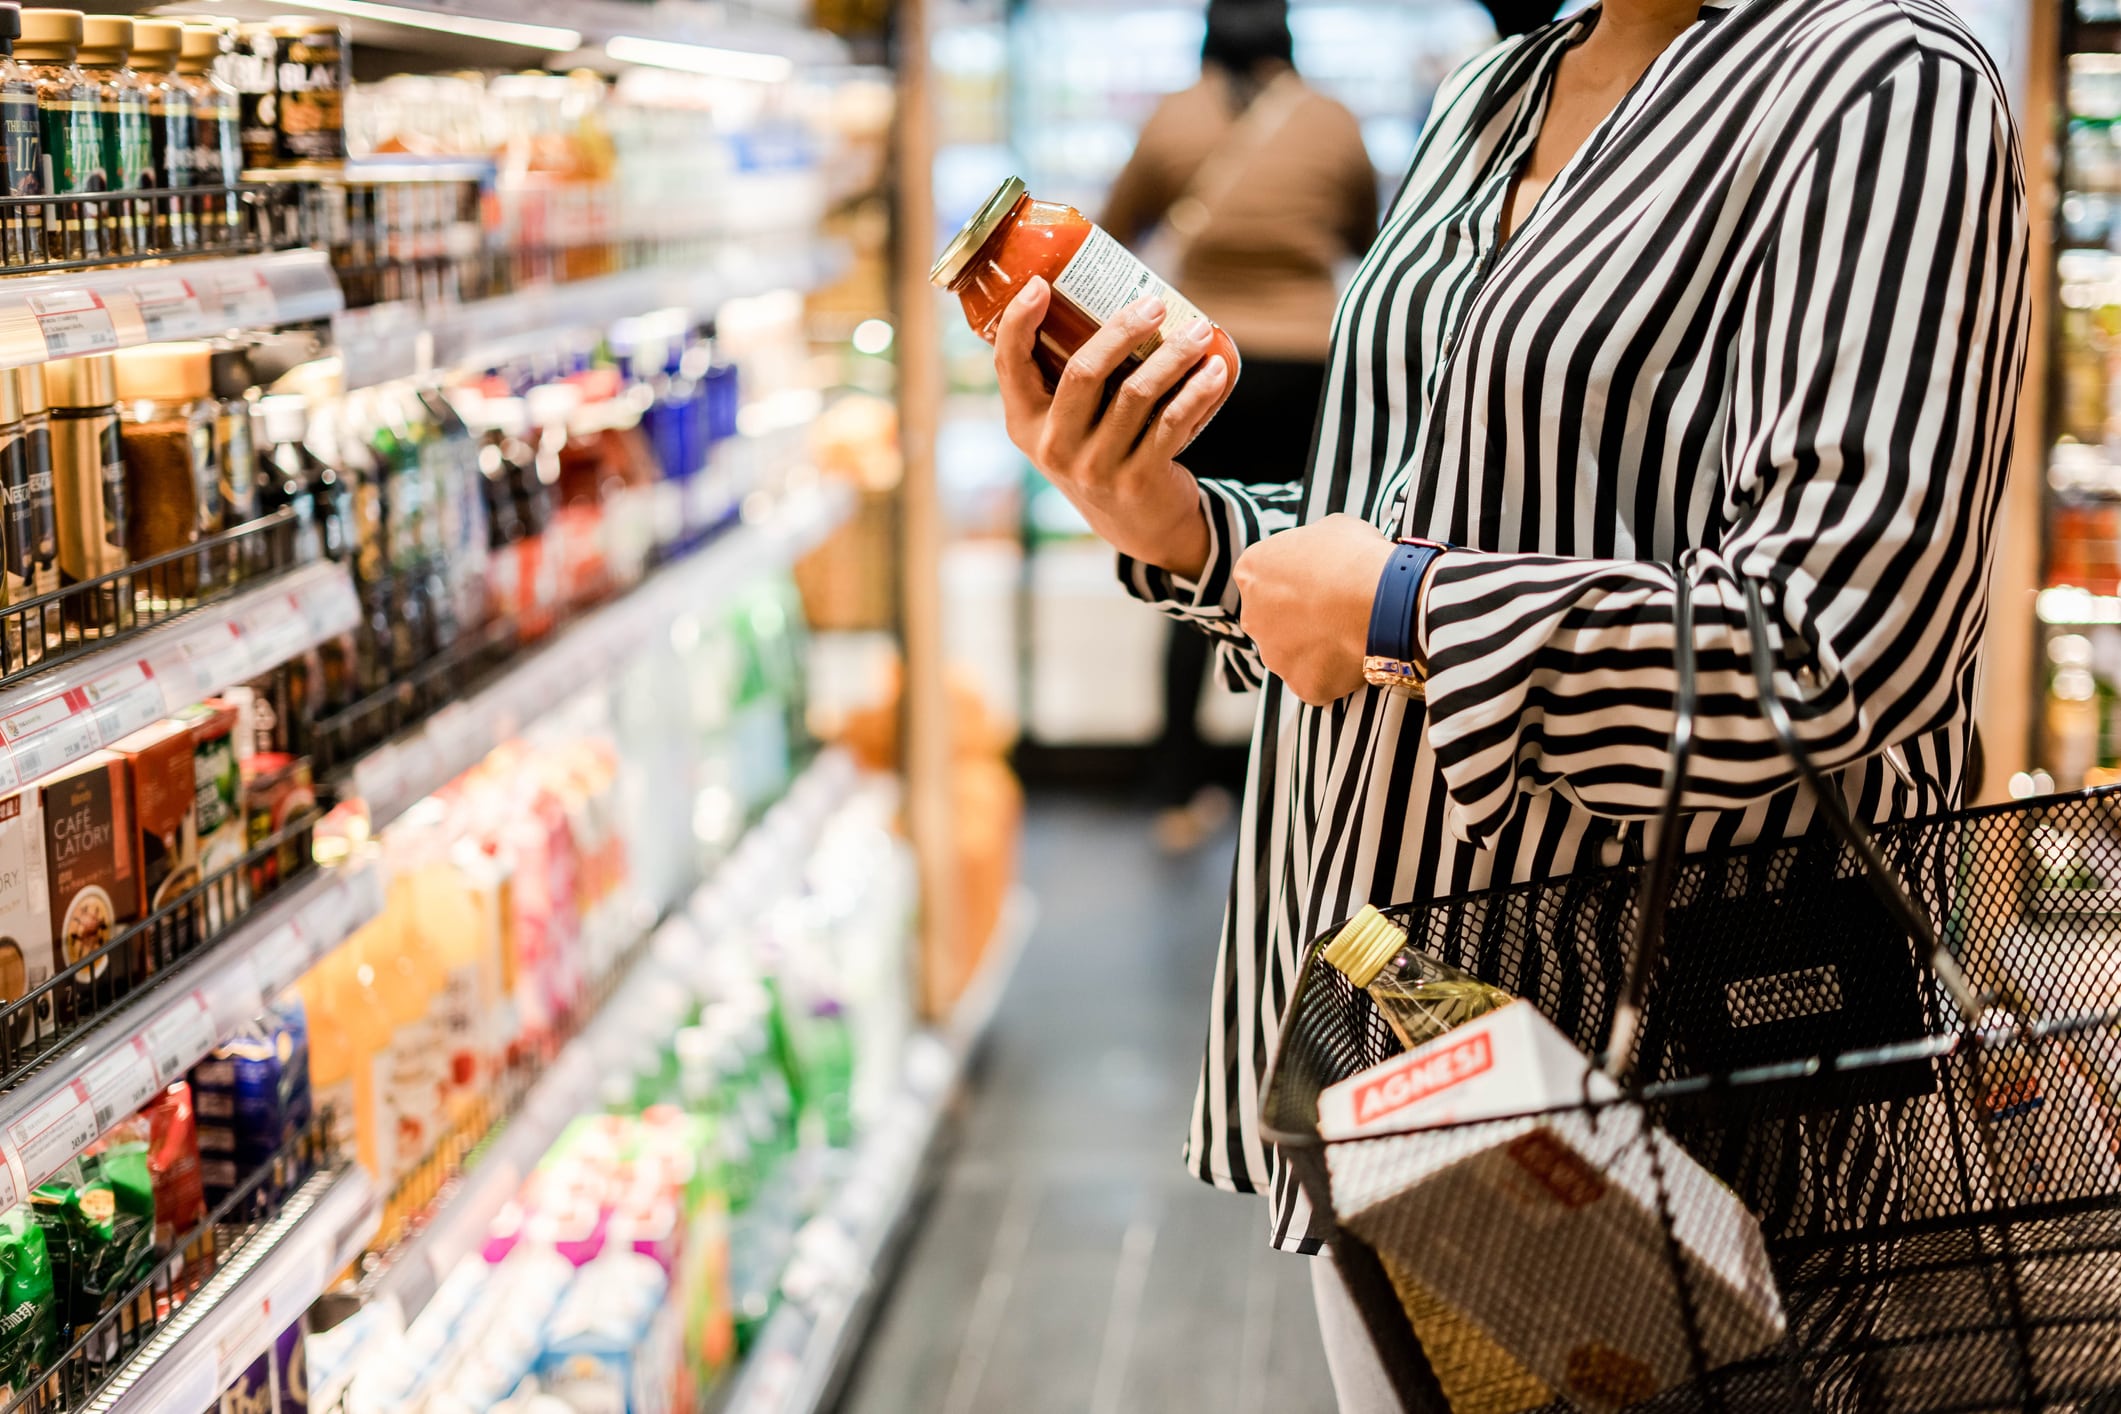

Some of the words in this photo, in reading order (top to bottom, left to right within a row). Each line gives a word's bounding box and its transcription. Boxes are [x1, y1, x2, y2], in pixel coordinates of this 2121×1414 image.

[15, 136, 39, 172] 117
[54, 805, 91, 839] CAFÉ
[55, 822, 110, 861] LATORY
[1360, 1038, 1488, 1119] AGNESI
